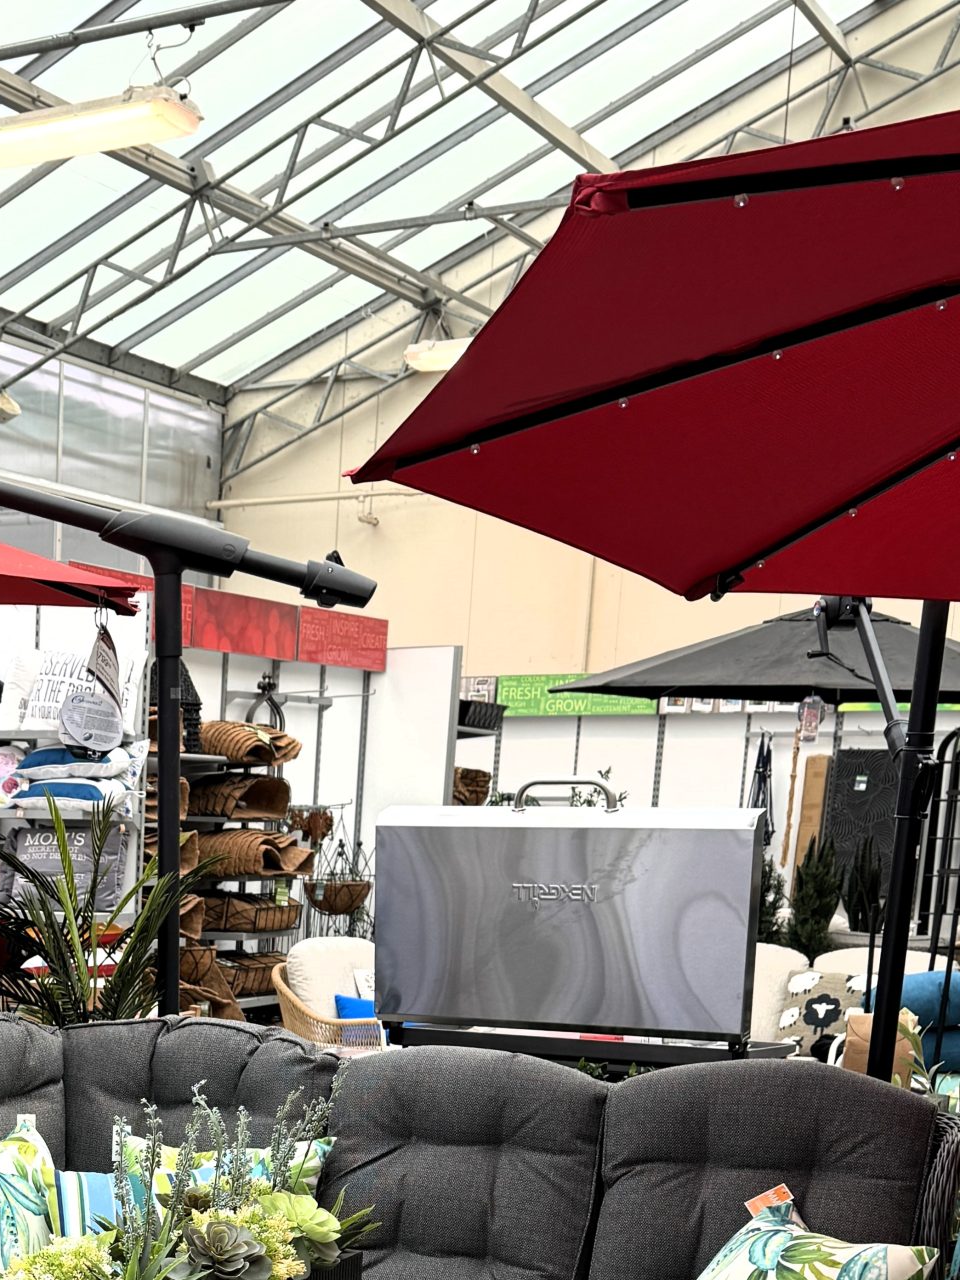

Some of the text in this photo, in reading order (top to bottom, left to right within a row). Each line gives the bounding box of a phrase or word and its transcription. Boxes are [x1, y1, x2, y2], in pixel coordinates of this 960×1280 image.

[302, 623, 325, 641] FRESH
[326, 644, 351, 662] GROW
[44, 679, 66, 703] THE
[502, 687, 541, 700] FRESH
[546, 699, 587, 712] GROW
